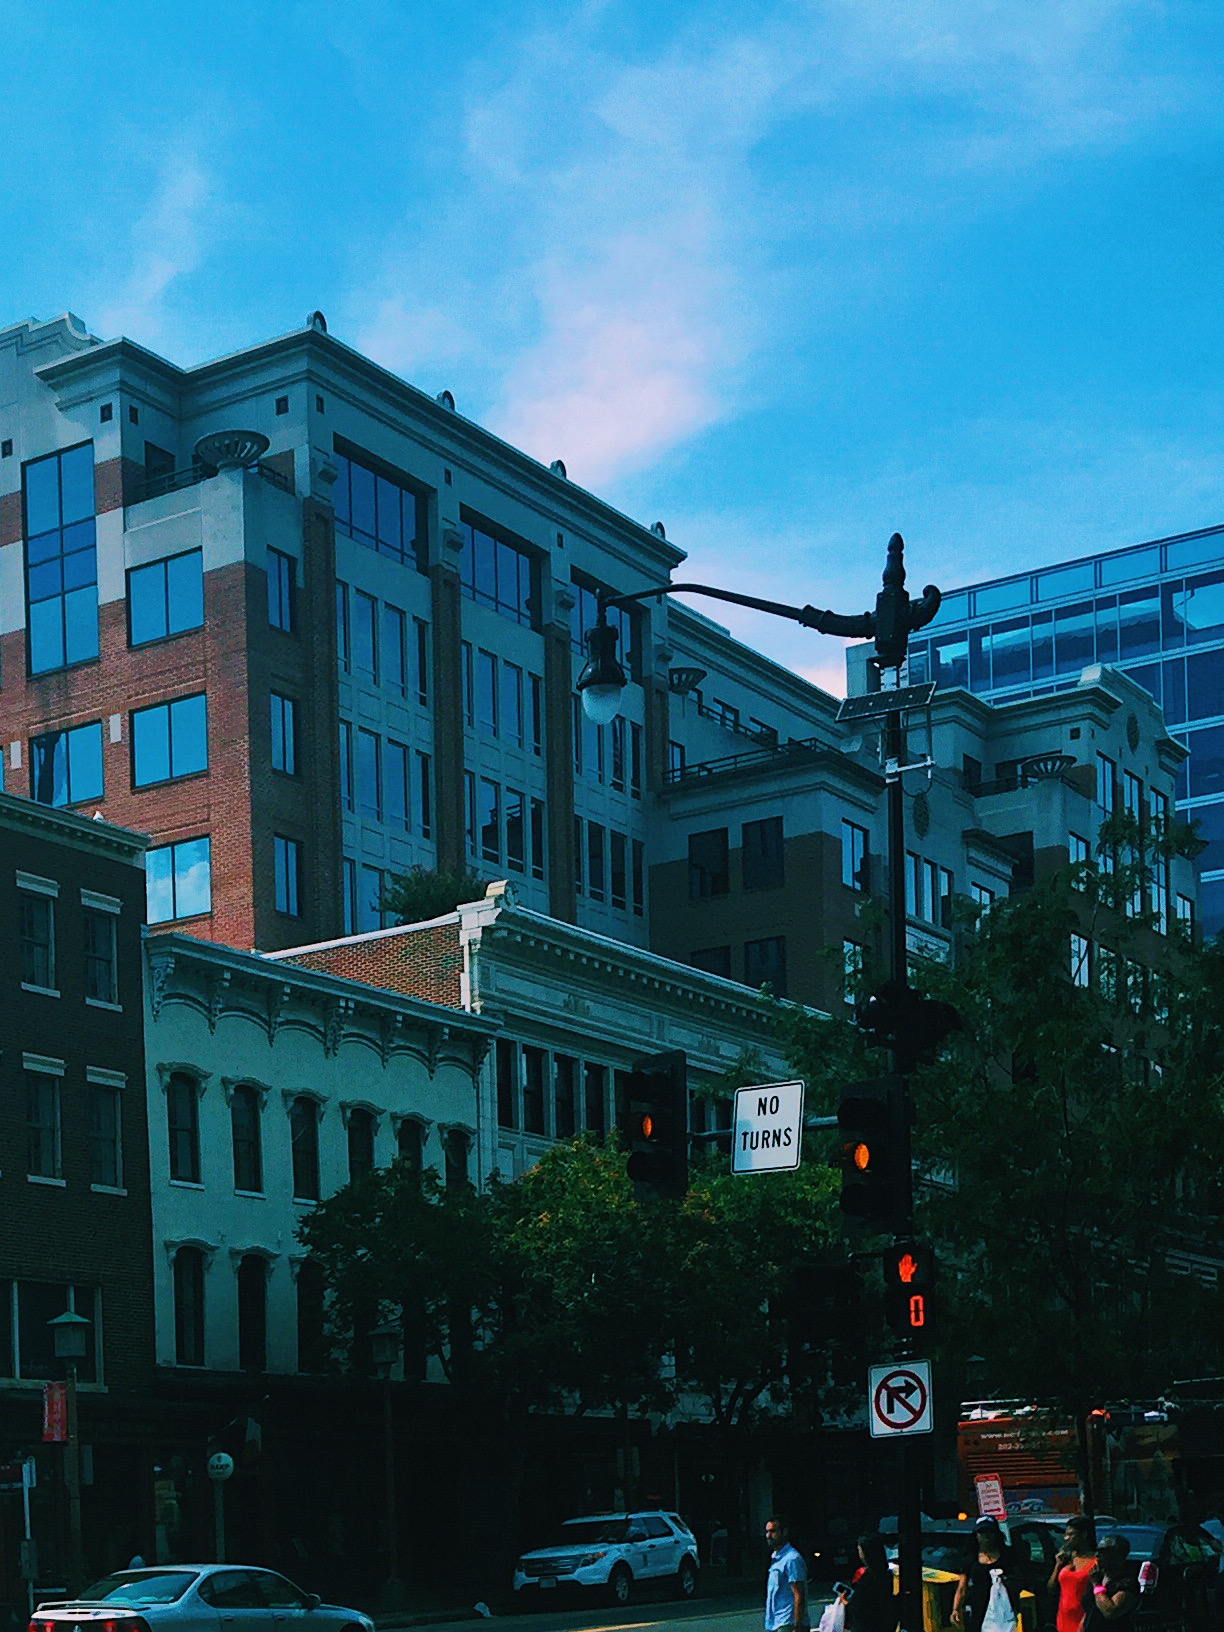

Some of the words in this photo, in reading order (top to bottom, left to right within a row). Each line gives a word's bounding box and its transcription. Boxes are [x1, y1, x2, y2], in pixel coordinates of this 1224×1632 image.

[757, 1095, 780, 1116] NO
[741, 1126, 793, 1151] TURNS
[909, 1294, 924, 1327] 0
